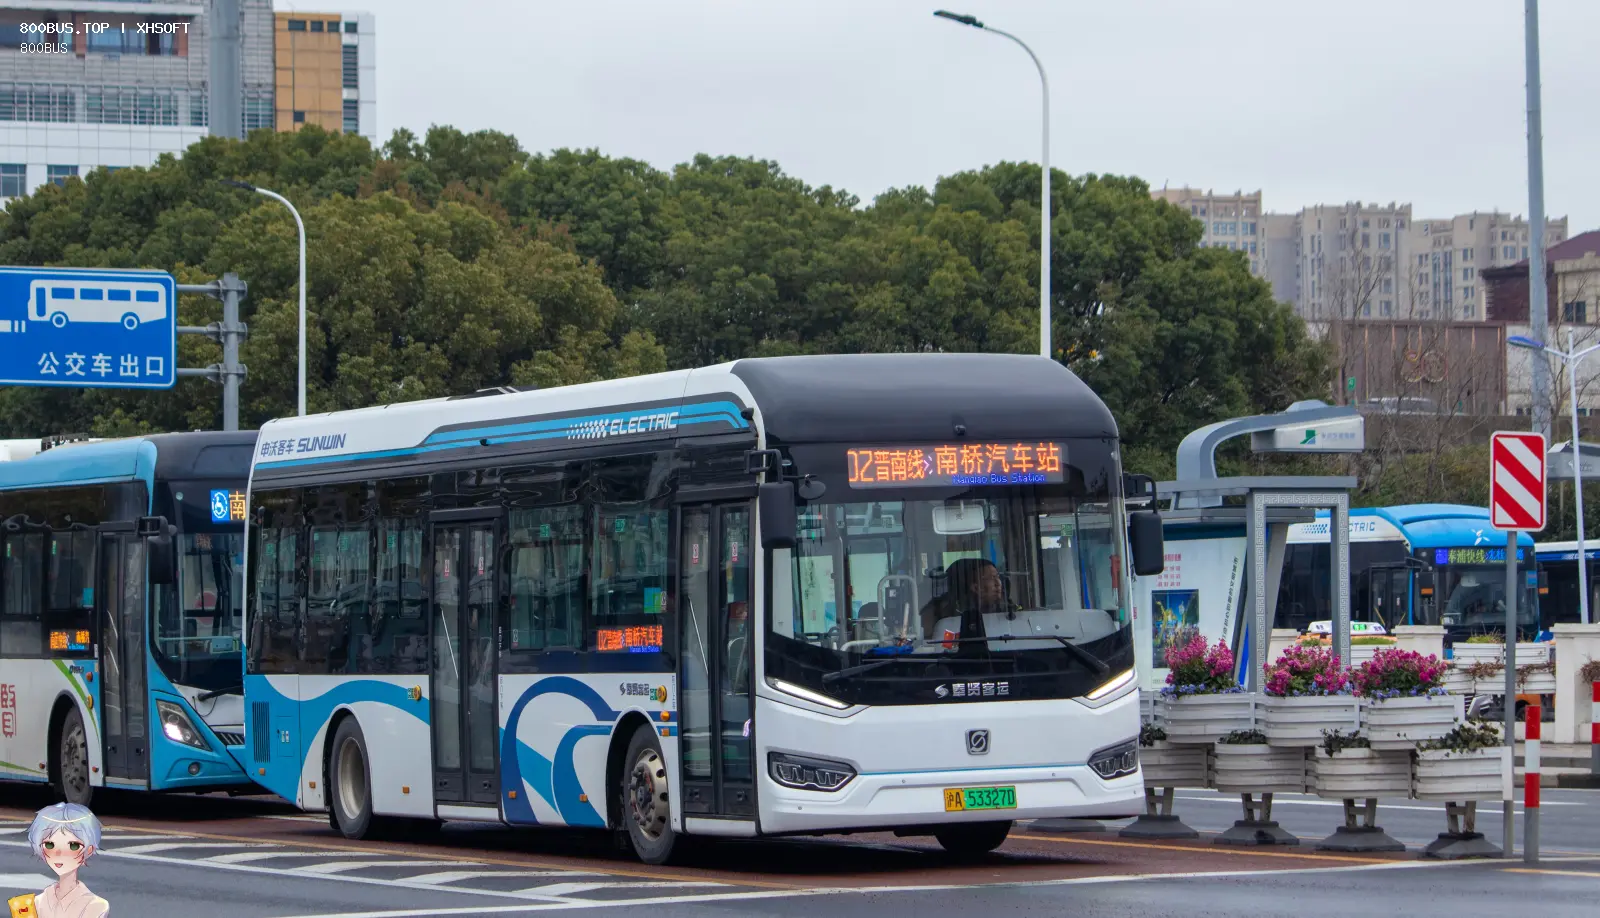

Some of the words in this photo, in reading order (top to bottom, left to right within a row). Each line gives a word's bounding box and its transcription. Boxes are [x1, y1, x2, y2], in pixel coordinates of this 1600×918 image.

[37, 352, 165, 378] 公交车出口
[609, 411, 679, 436] ELECTRIC
[260, 439, 296, 457] 申沃客车
[296, 433, 347, 453] SUNWIN
[934, 442, 1061, 475] 南桥汽车站
[990, 473, 1008, 483] Bus
[1011, 472, 1046, 483] Station
[228, 489, 247, 521] 南
[952, 681, 1010, 697] 奉贤客运
[968, 788, 1016, 807] 53327D
